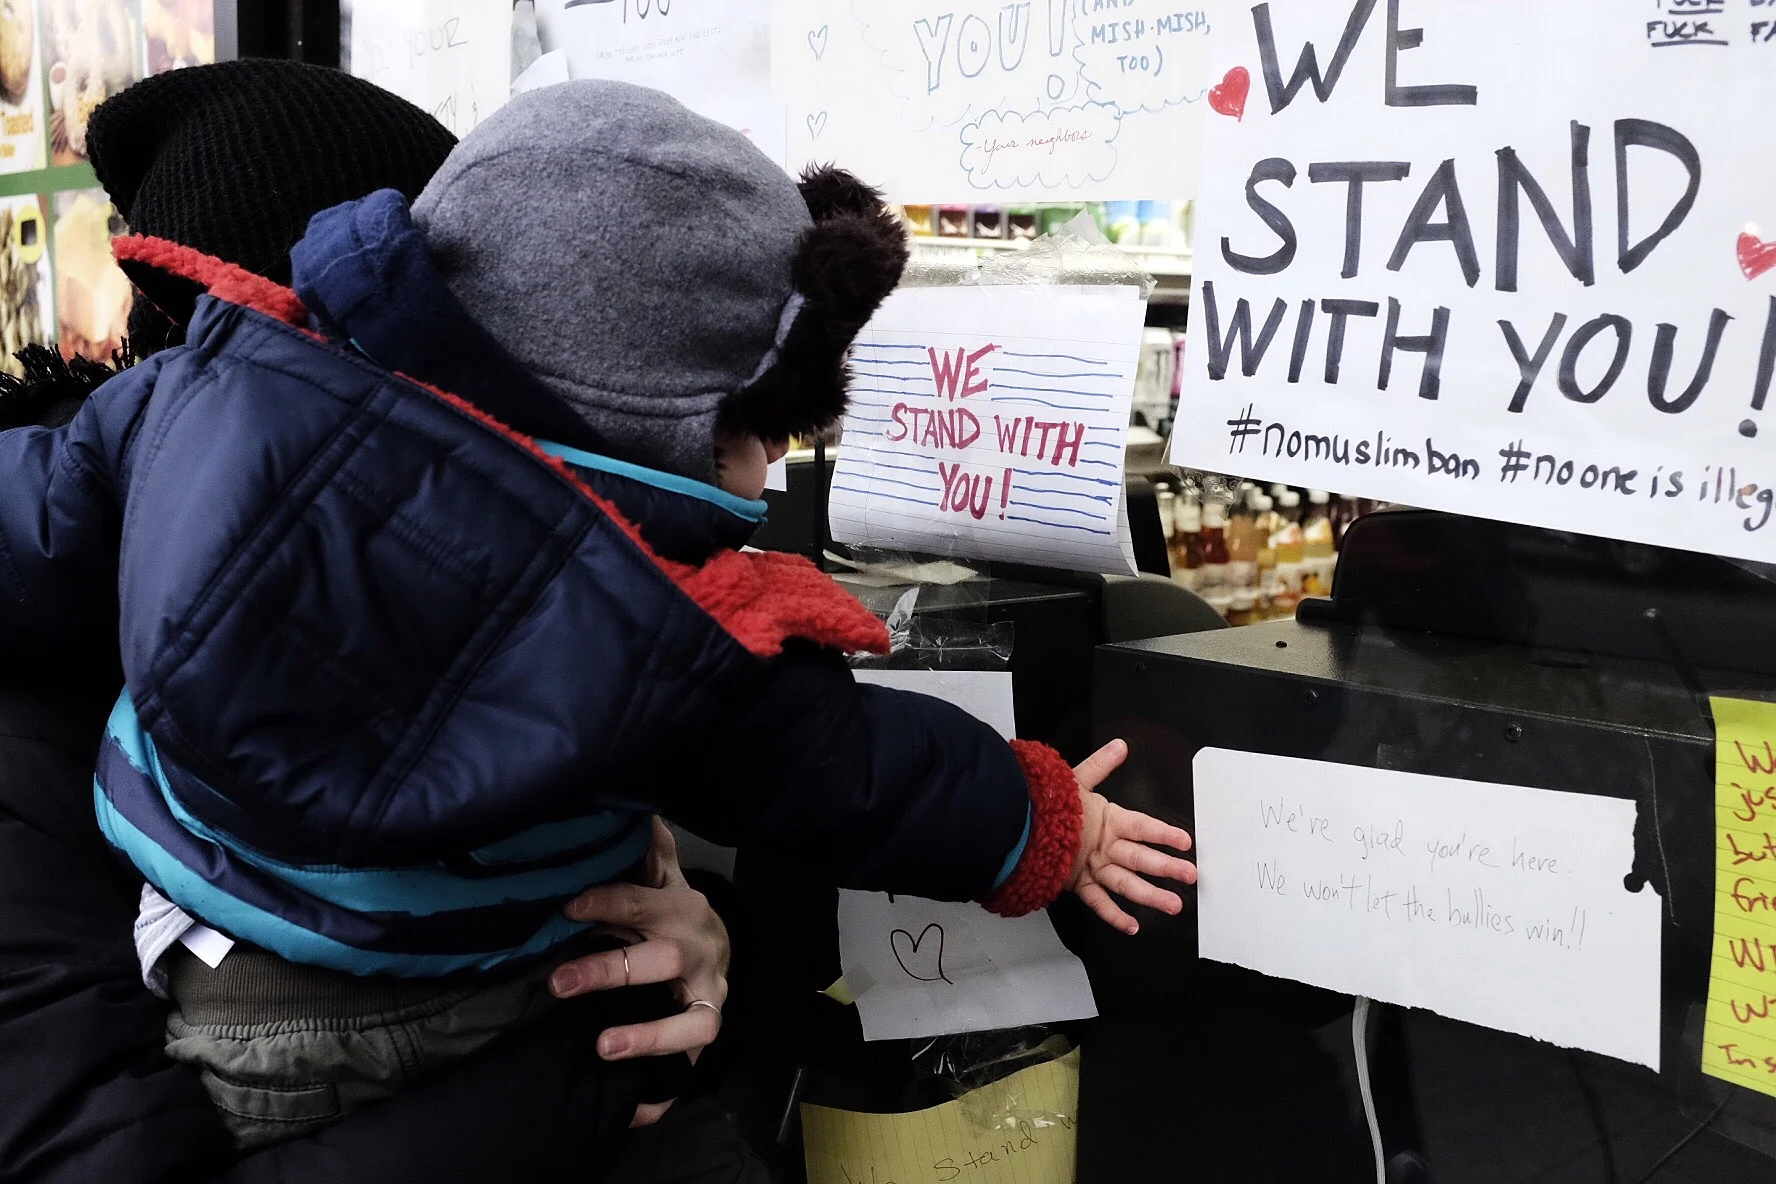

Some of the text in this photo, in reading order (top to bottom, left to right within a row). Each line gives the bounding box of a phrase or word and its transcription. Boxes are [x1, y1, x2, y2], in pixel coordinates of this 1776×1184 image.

[913, 0, 1066, 100] YOU!
[1117, 45, 1163, 77] TOO)
[1251, 0, 1478, 115] WE
[1646, 20, 1714, 39] FUCK
[1026, 128, 1093, 155] neighbors
[1220, 117, 1702, 292] STAND
[928, 343, 1002, 402] WE
[1202, 280, 1776, 438] WITH YOU!
[885, 402, 1085, 467] STAND WITH
[1227, 402, 1481, 480] #nomuslimban
[1698, 465, 1776, 531] illeg
[938, 461, 1012, 520] YOU!
[1260, 797, 1572, 874] We're glad you're here.
[1257, 859, 1586, 951] We won't let the bullies win!!
[1730, 877, 1776, 912] fri
[934, 1120, 1038, 1182] Stand
